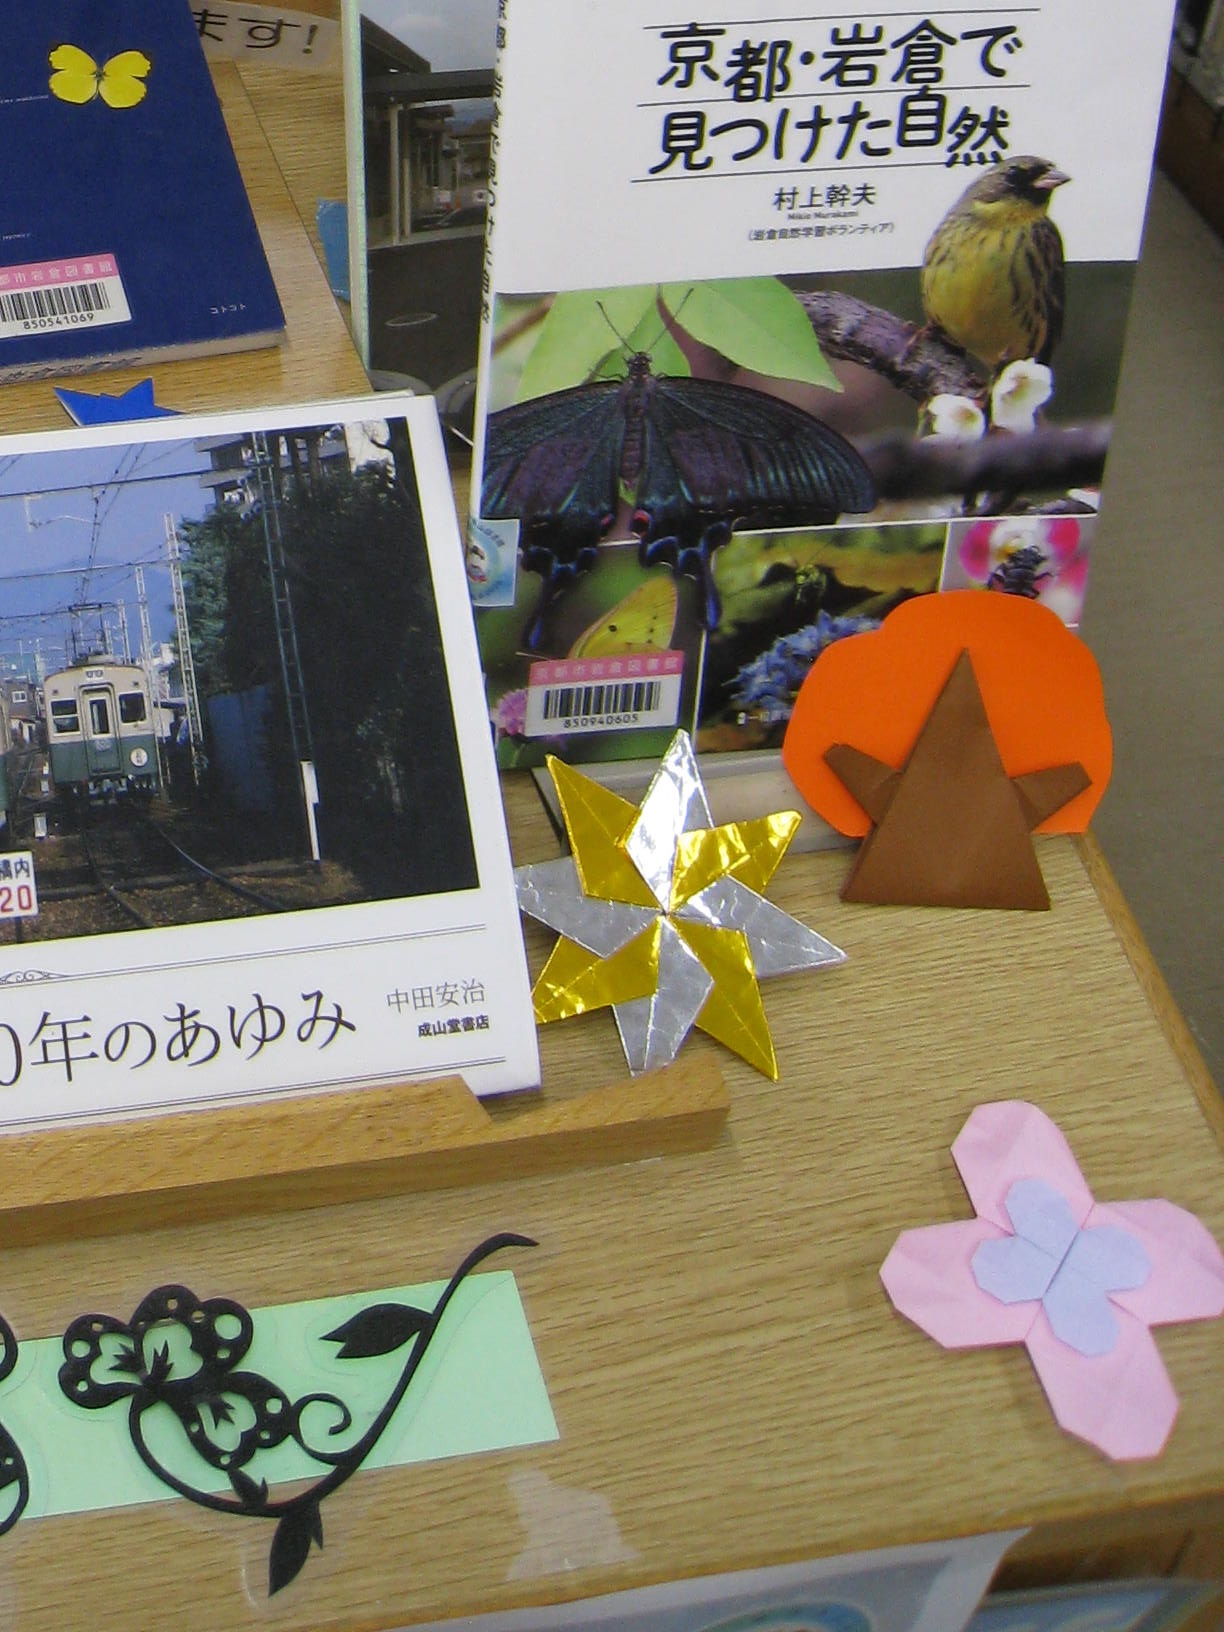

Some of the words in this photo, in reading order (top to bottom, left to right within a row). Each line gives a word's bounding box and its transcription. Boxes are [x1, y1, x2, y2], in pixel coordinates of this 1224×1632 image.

[657, 18, 1023, 102] 京都・岩倉で
[649, 85, 1009, 176] 見つけた自然
[773, 183, 876, 211] 村上幹夫
[23, 311, 95, 330] 850541069
[563, 713, 640, 729] 850940605
[386, 978, 486, 1014] 中田安治
[417, 1014, 490, 1039] 成山堂書店
